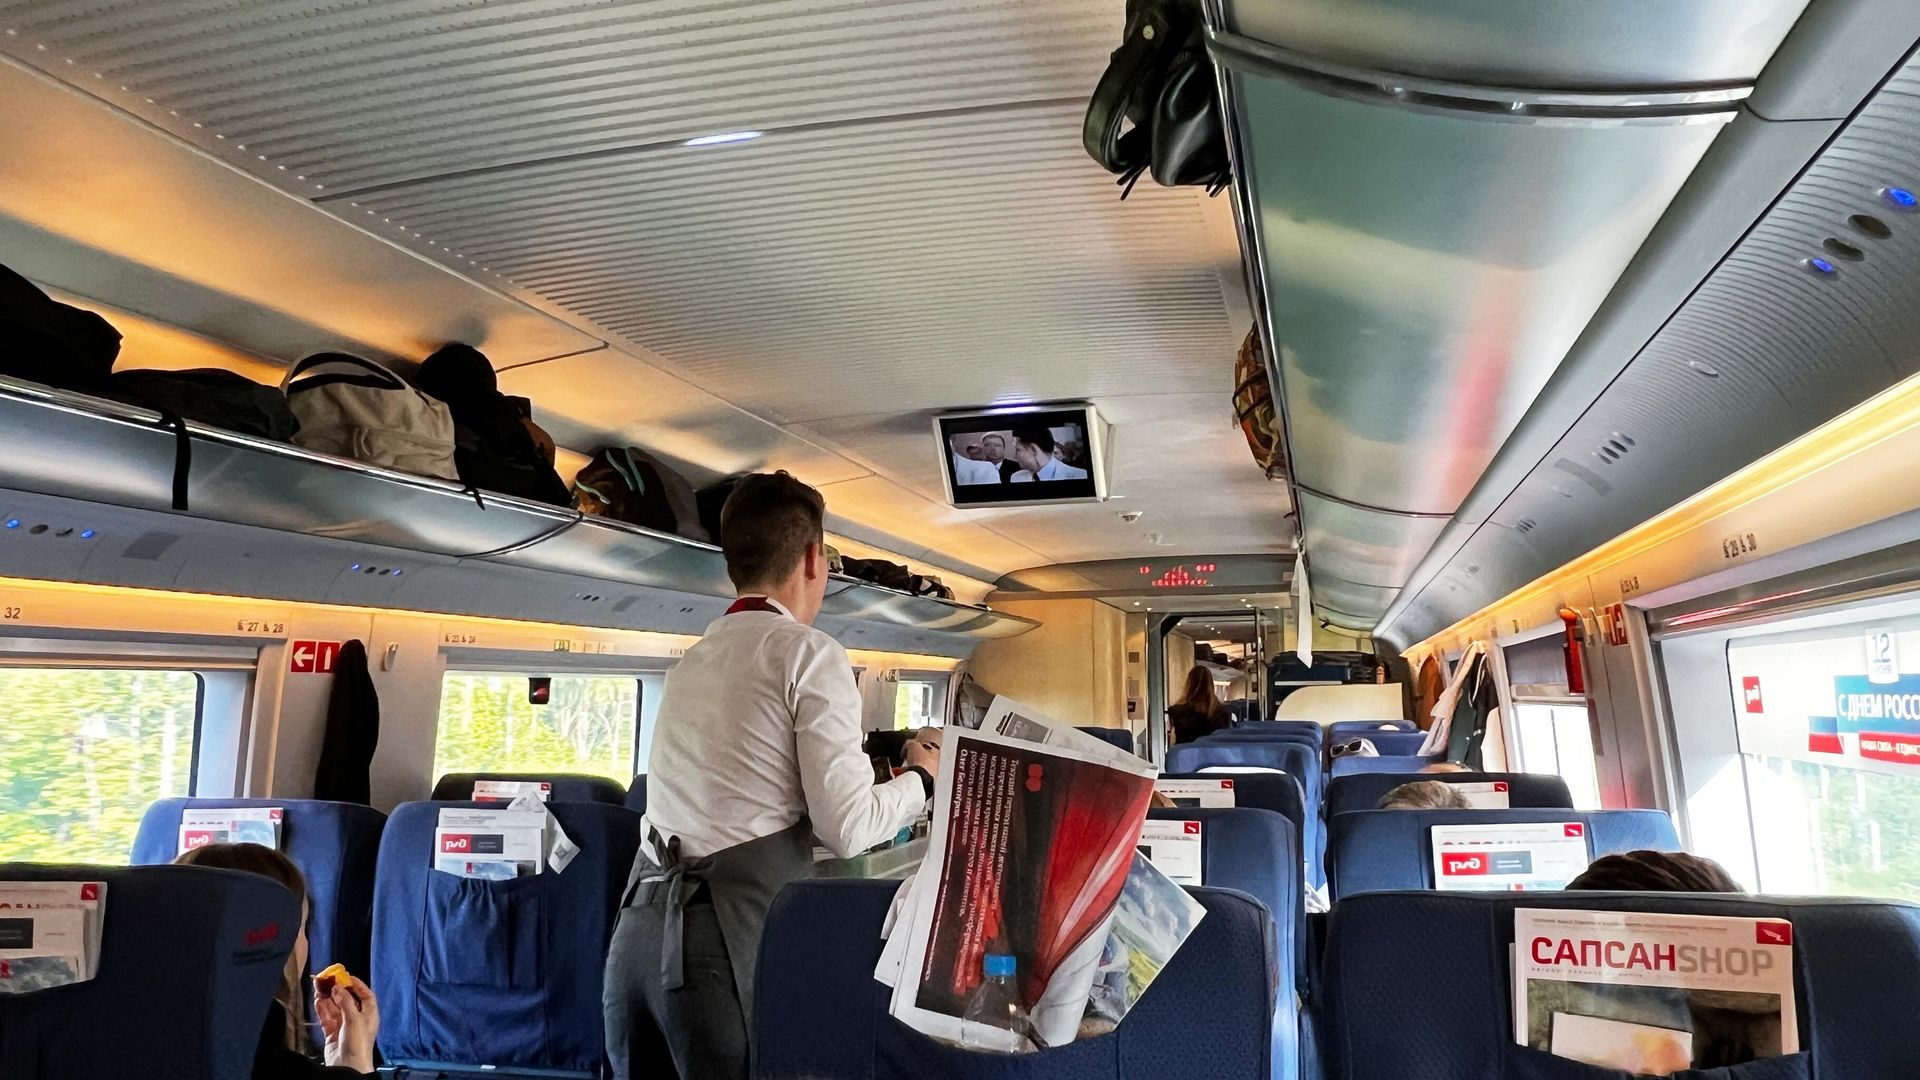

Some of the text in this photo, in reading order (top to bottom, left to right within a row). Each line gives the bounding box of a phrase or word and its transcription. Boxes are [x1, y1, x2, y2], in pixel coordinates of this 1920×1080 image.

[4, 606, 21, 619] 32
[247, 621, 284, 634] 27 28
[958, 748, 968, 771] Олег
[1531, 936, 1774, 977] САПСАНSHOP
